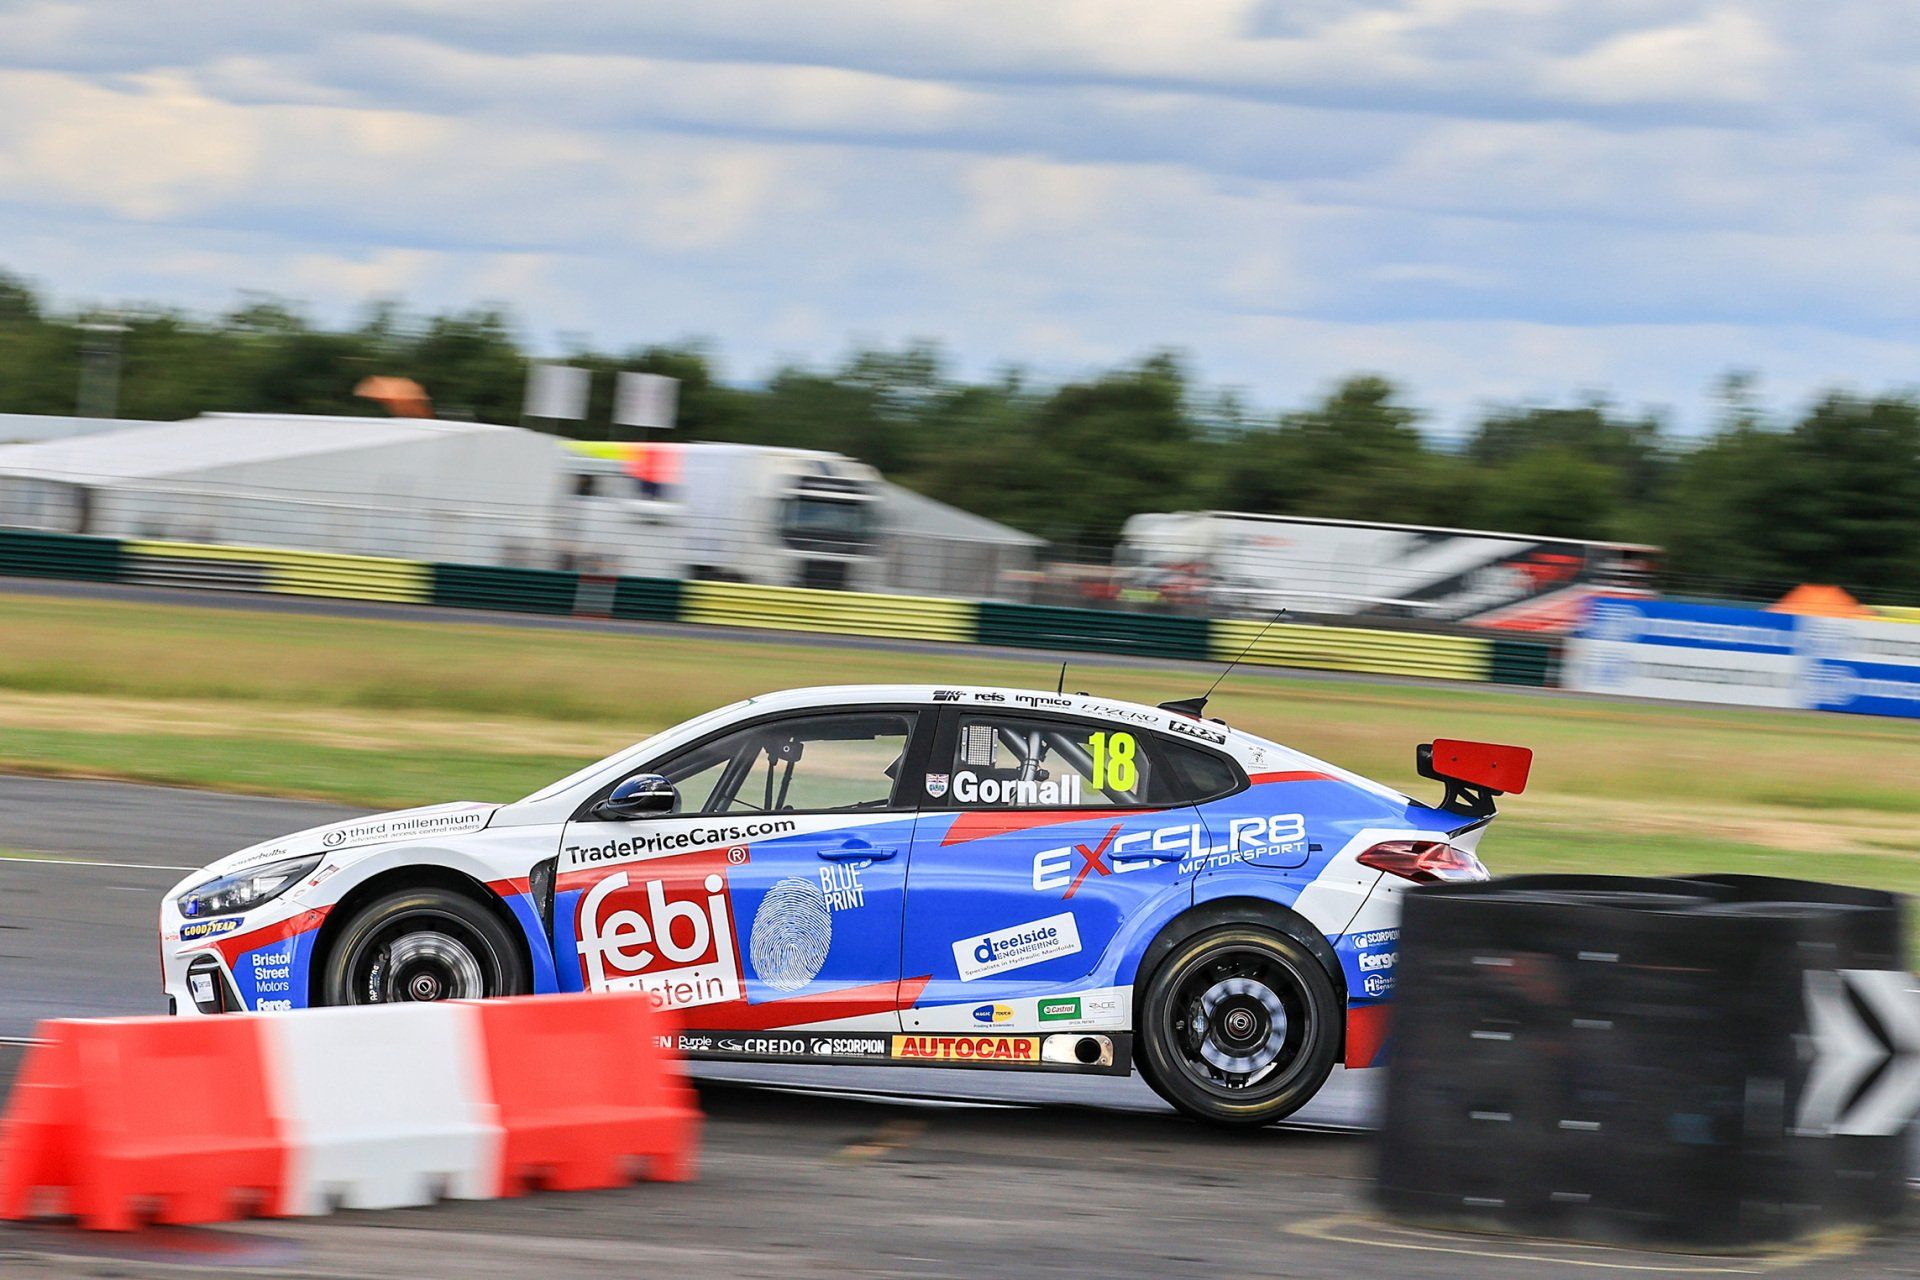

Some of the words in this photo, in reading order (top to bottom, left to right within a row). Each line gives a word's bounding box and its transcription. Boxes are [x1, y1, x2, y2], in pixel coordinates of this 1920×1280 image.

[974, 692, 1006, 702] reis
[1089, 731, 1136, 792] 18
[952, 770, 1081, 805] Gornall
[349, 823, 386, 838] third
[392, 813, 480, 831] millennium
[418, 826, 447, 836] control
[449, 823, 480, 832] readers
[566, 818, 796, 865] TradePriceCars.com
[1178, 841, 1305, 875] MOTORSPORT
[819, 861, 862, 894] BLUE
[823, 886, 866, 913] PRINT
[184, 921, 238, 937] GOODYEAR
[576, 869, 740, 994] febi
[974, 927, 1057, 964] dreelside
[997, 938, 1059, 960] ENGINEERING
[252, 951, 291, 967] Bristol
[254, 967, 290, 980] Street
[256, 981, 290, 993] Motors
[605, 971, 724, 1008] stein
[1051, 1006, 1074, 1014] Castrol
[678, 1035, 712, 1049] Purple
[744, 1038, 806, 1053] CREDO
[832, 1039, 885, 1053] SCORPION
[901, 1037, 1032, 1060] AUTOCAR
